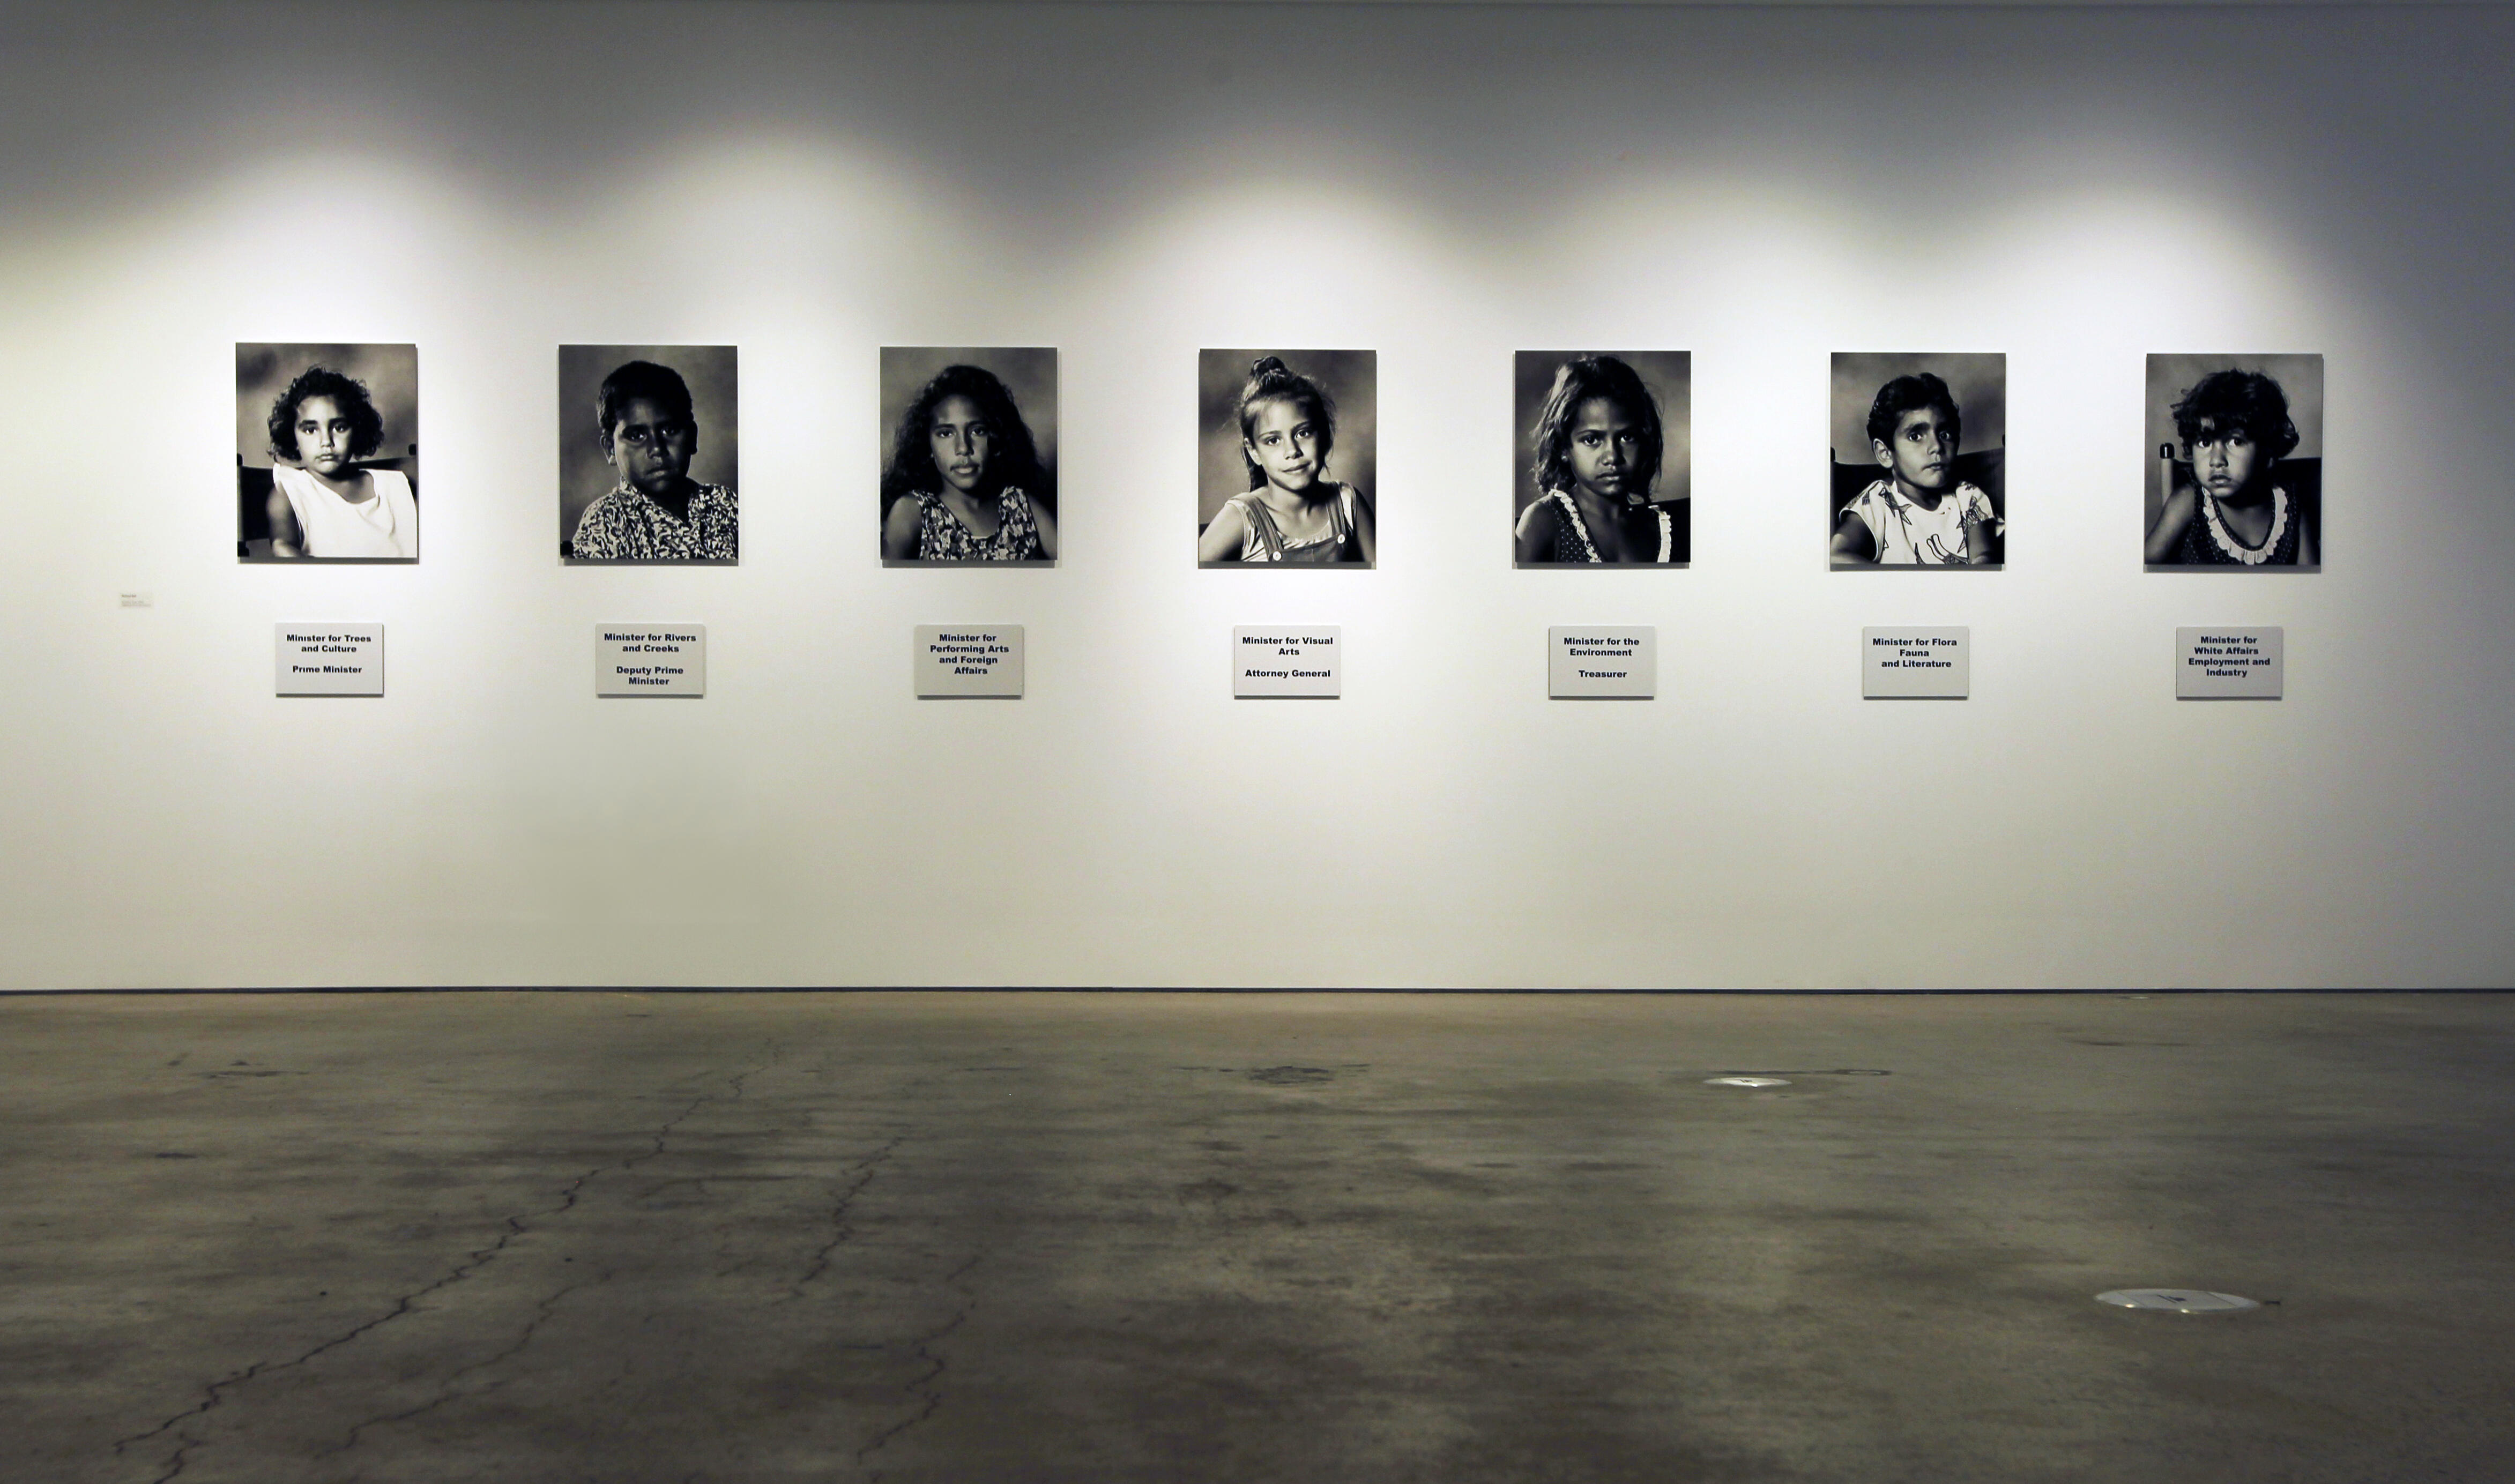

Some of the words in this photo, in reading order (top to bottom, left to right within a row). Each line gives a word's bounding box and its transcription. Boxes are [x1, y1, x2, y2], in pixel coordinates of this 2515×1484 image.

[287, 634, 325, 642] Minister
[604, 633, 645, 642] Minister
[648, 633, 662, 642] for
[665, 633, 696, 642] Rivers
[939, 633, 980, 642] Minister
[983, 633, 996, 642] for
[1285, 637, 1299, 645] for
[1302, 637, 1333, 645] Visual
[1564, 637, 1604, 645] Minister
[1606, 637, 1621, 645] for
[2200, 636, 2241, 644] Minister
[2243, 636, 2257, 644] for
[1873, 638, 1913, 646] Minister
[1915, 638, 1929, 646] for
[622, 644, 641, 652] and
[644, 644, 679, 652] Creeks
[930, 645, 985, 654] Performing
[987, 645, 1009, 653] Arts
[1278, 647, 1300, 655] Arts
[2194, 647, 2223, 655] White
[2226, 647, 2259, 655] Affairs
[1569, 648, 1632, 657] Environment
[939, 655, 957, 663] and
[961, 655, 998, 666] Foreign
[1902, 660, 1952, 668] Literature
[2188, 658, 2249, 667] Employment
[2252, 658, 2271, 666] and
[292, 665, 320, 673] Prime
[616, 666, 652, 676] Deputy
[654, 666, 684, 674] Prime
[954, 666, 988, 675] Affairs
[2206, 668, 2248, 678] Industry
[1245, 669, 1289, 679] Attorney
[1291, 669, 1330, 677] General
[1578, 670, 1627, 678] Treasurer
[628, 677, 669, 685] Minister
